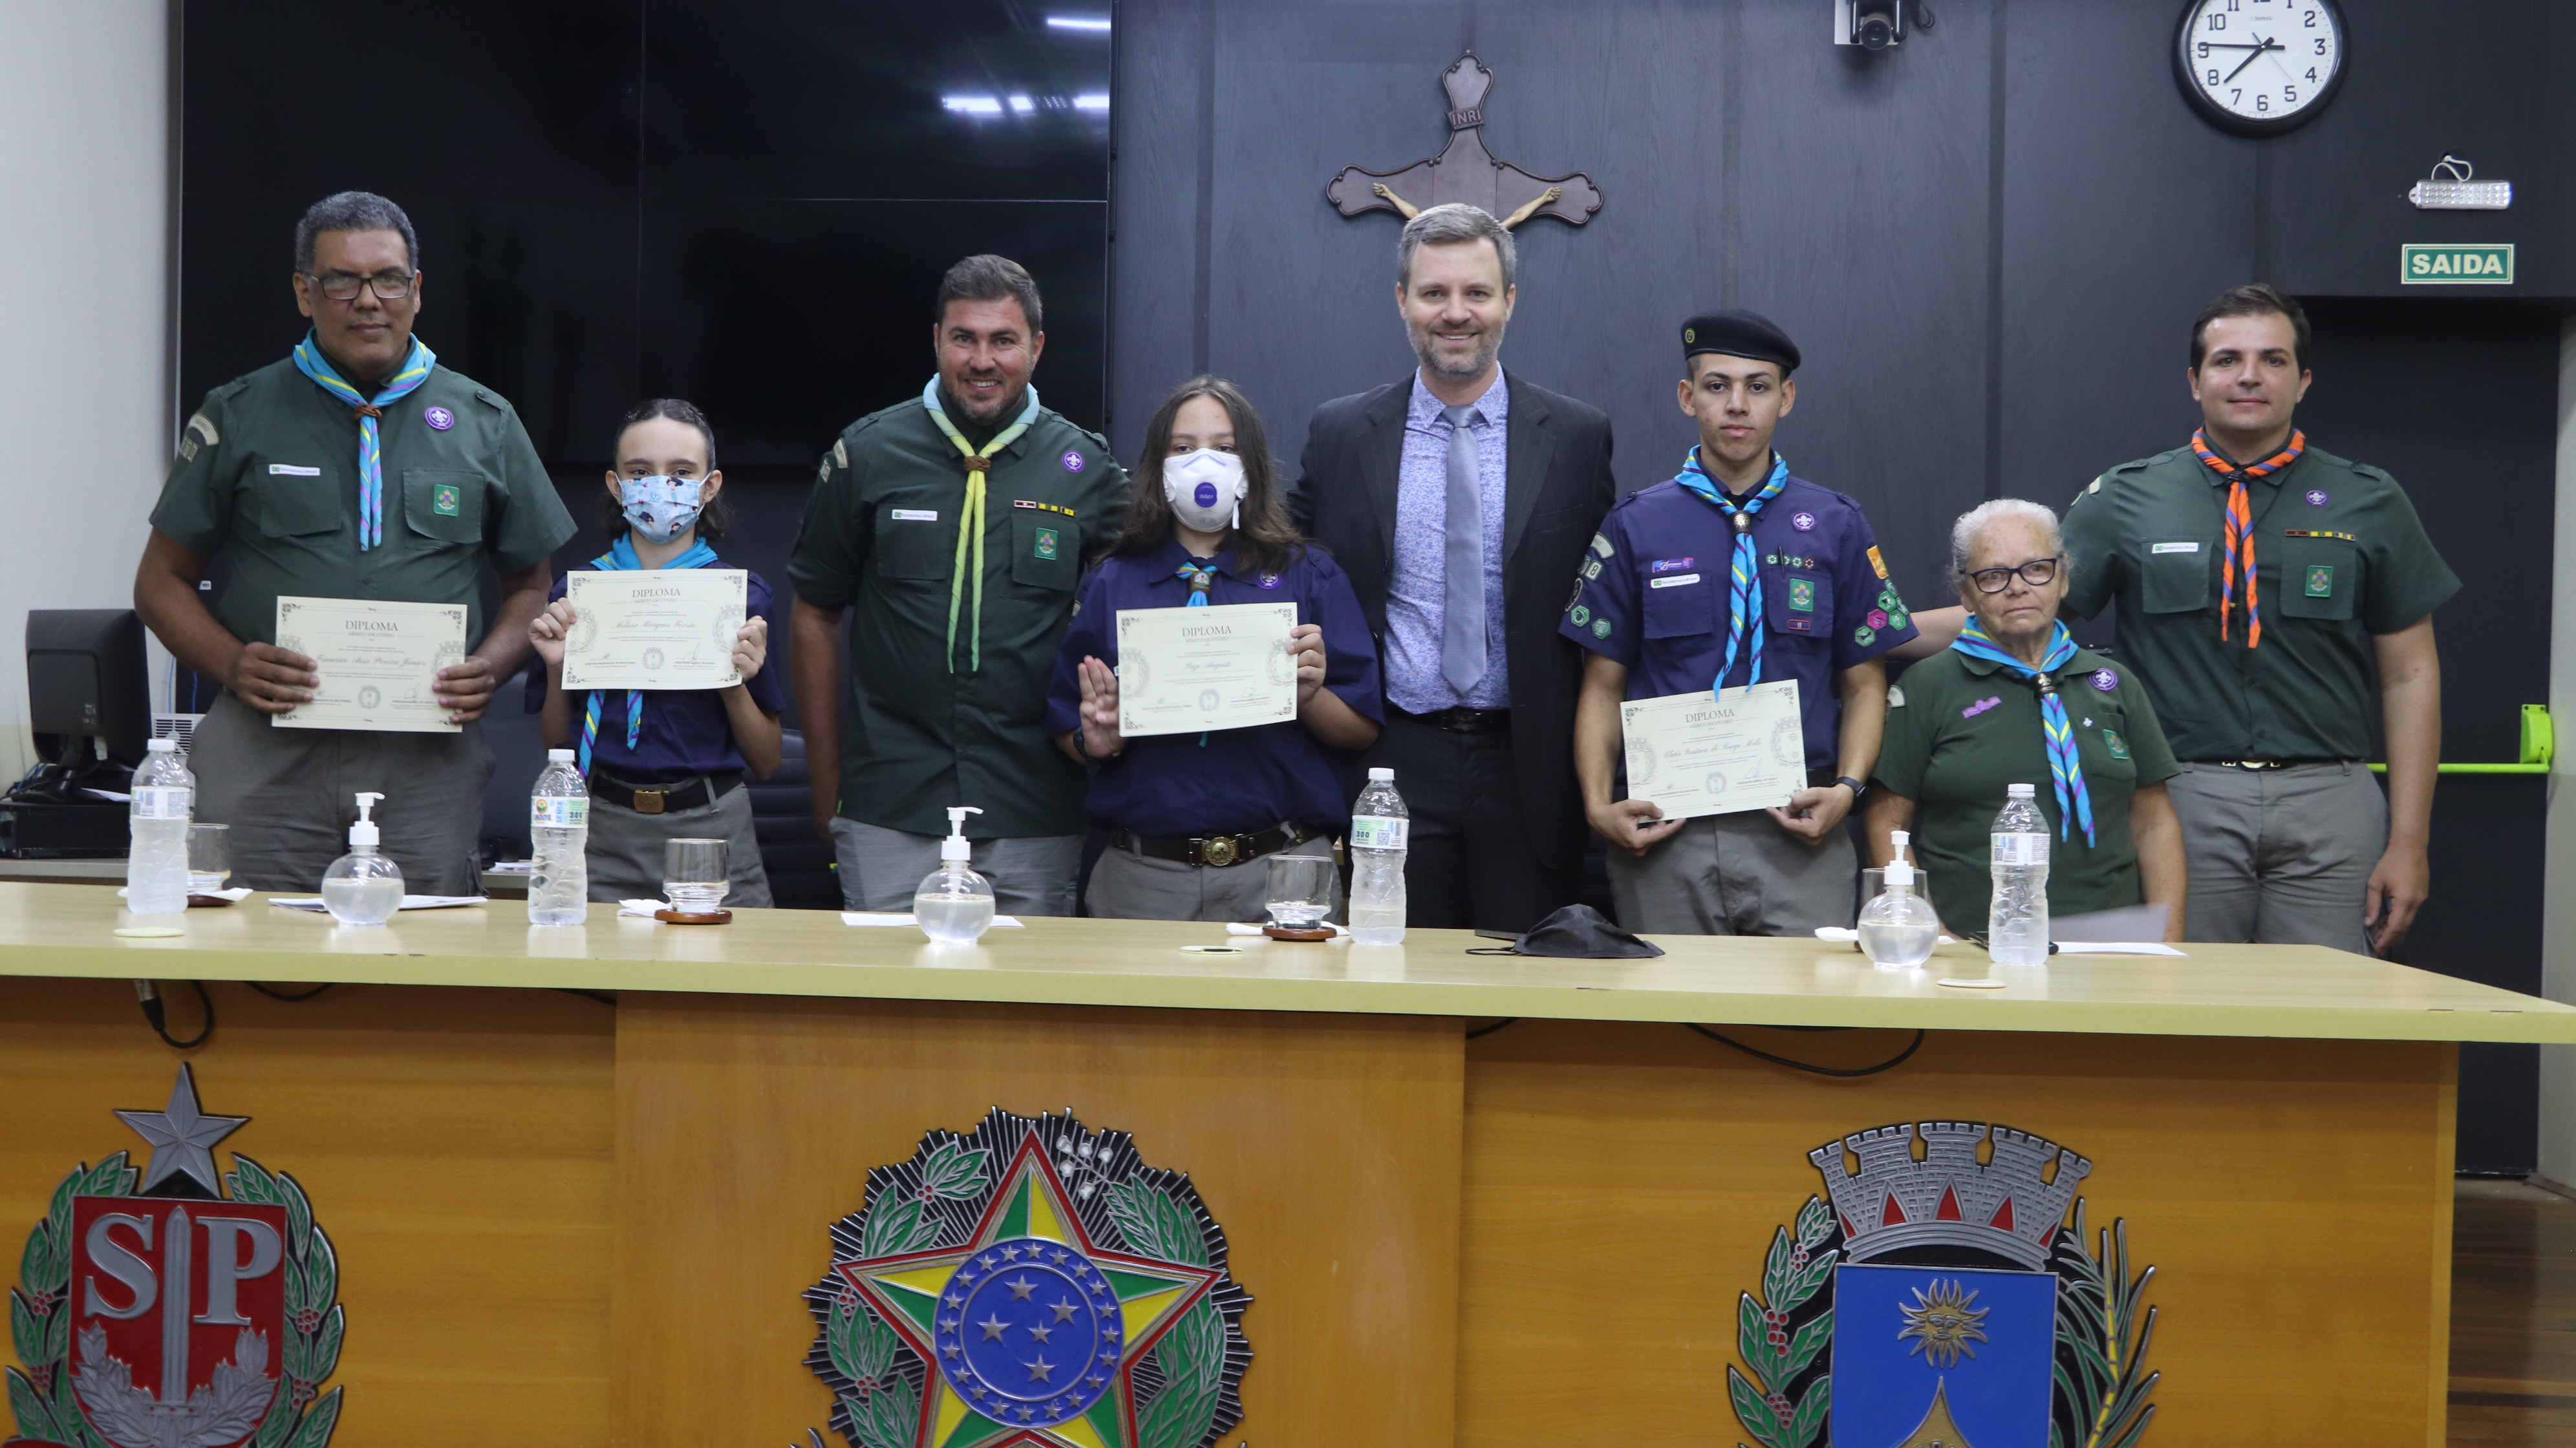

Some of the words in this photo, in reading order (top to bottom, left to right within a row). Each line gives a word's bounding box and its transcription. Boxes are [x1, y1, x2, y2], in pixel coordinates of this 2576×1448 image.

[2207, 14, 2226, 30] 10
[2304, 10, 2316, 27] 2
[2198, 42, 2209, 58] 9
[2314, 38, 2326, 56] 3
[2207, 69, 2219, 86] 8
[2305, 67, 2317, 83] 4
[2231, 89, 2242, 105] 7
[2284, 85, 2297, 102] 5
[2257, 95, 2268, 112] 6
[1452, 109, 1481, 125] INRI
[2412, 253, 2504, 275] SAIDA
[1590, 564, 1598, 576] 8
[632, 588, 681, 598] DIPLOMA
[345, 620, 398, 632] DIPLOMA
[1182, 626, 1232, 637] DIPLOMA
[1686, 708, 1735, 723] DIPLOMA
